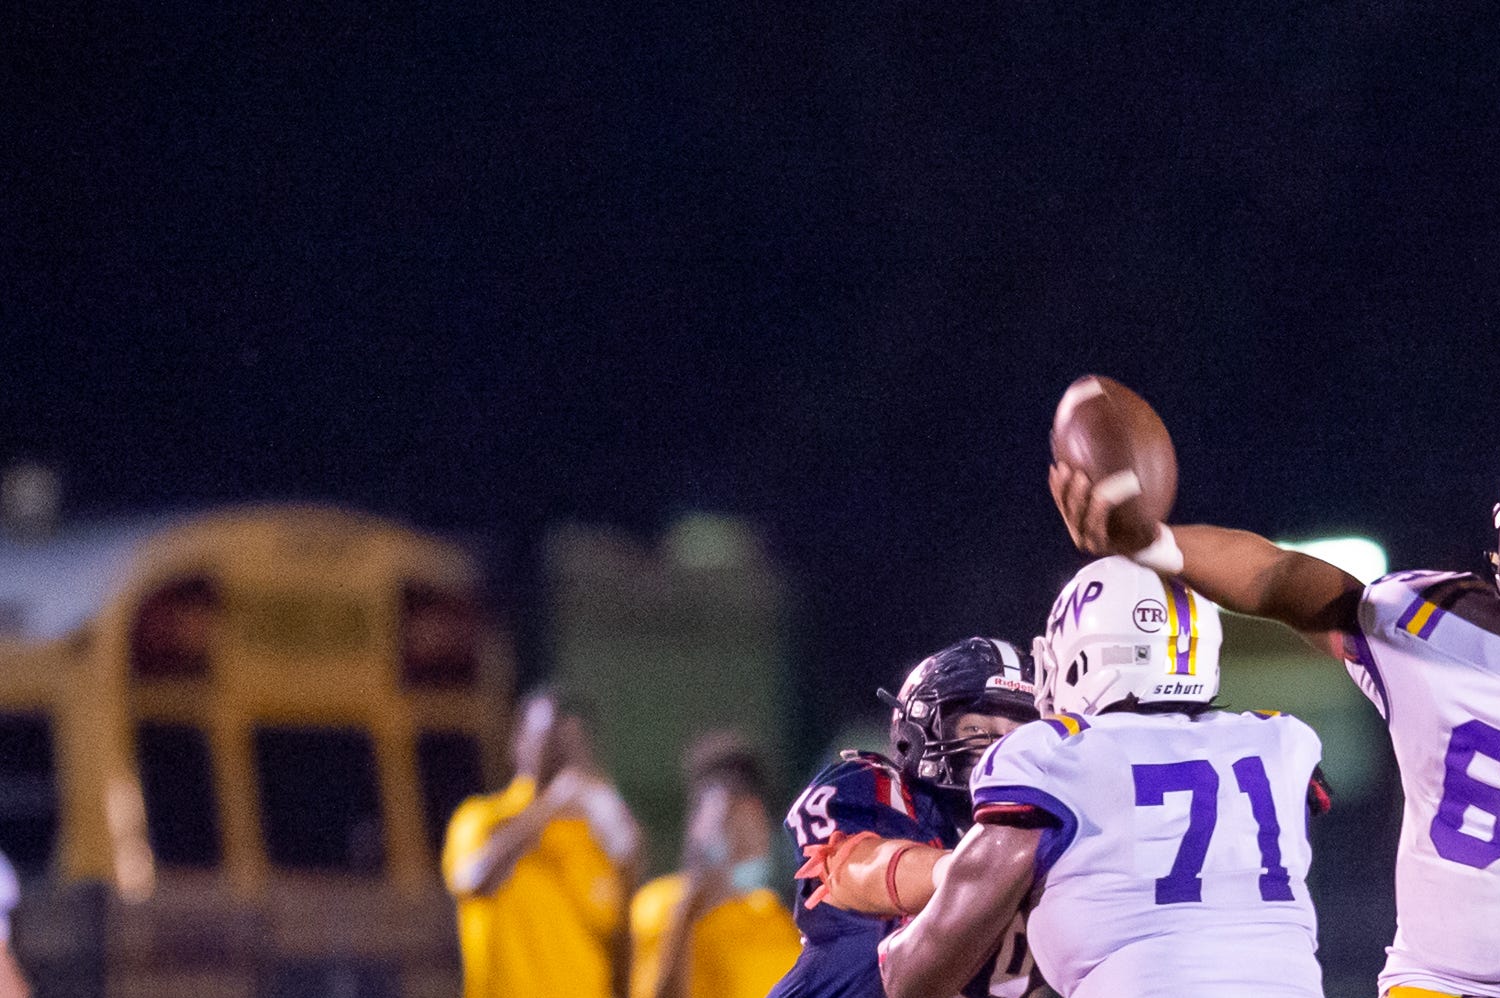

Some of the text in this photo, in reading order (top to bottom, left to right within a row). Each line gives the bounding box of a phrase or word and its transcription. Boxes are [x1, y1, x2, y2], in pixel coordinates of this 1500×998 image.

[1136, 608, 1165, 623] TR
[786, 785, 838, 848] 19
[1131, 756, 1296, 905] 71
